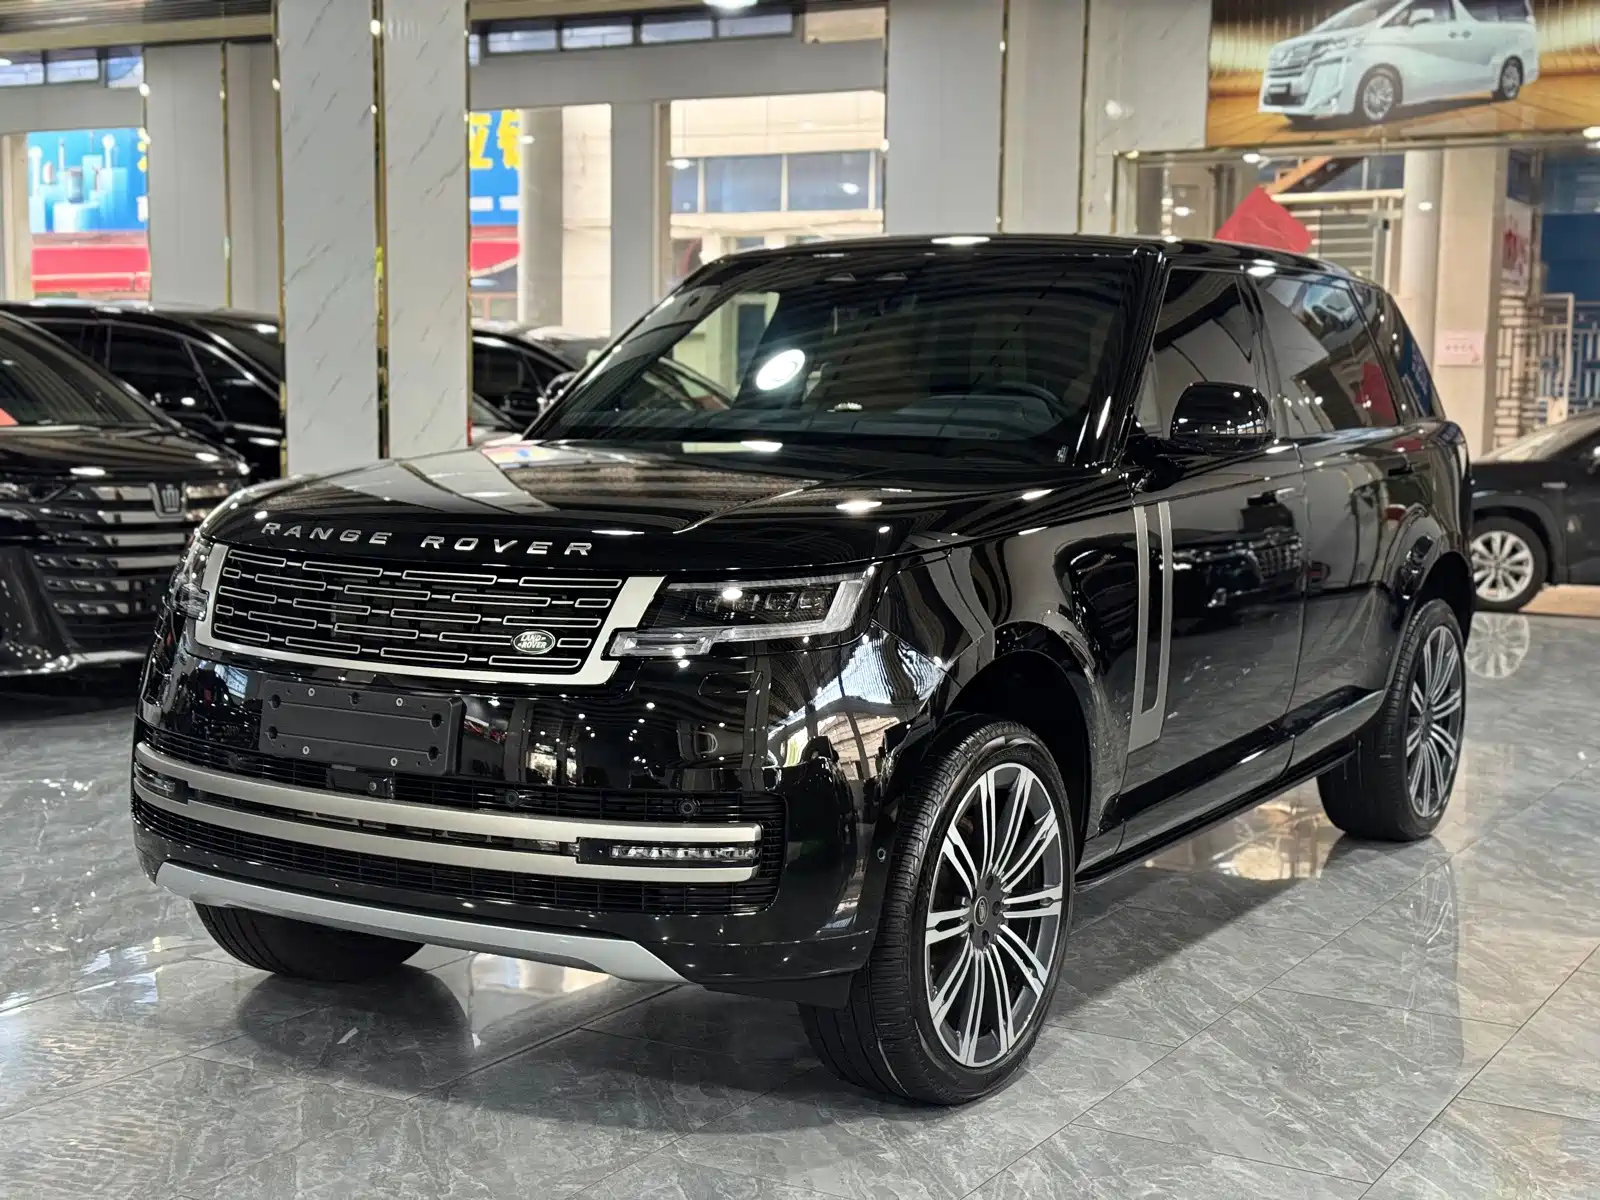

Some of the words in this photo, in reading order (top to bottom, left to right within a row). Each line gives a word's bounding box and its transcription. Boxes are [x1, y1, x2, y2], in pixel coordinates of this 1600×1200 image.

[261, 522, 392, 545] RANGE
[420, 535, 592, 556] ROVER
[520, 634, 542, 642] LAND
[520, 641, 547, 649] ROVER
